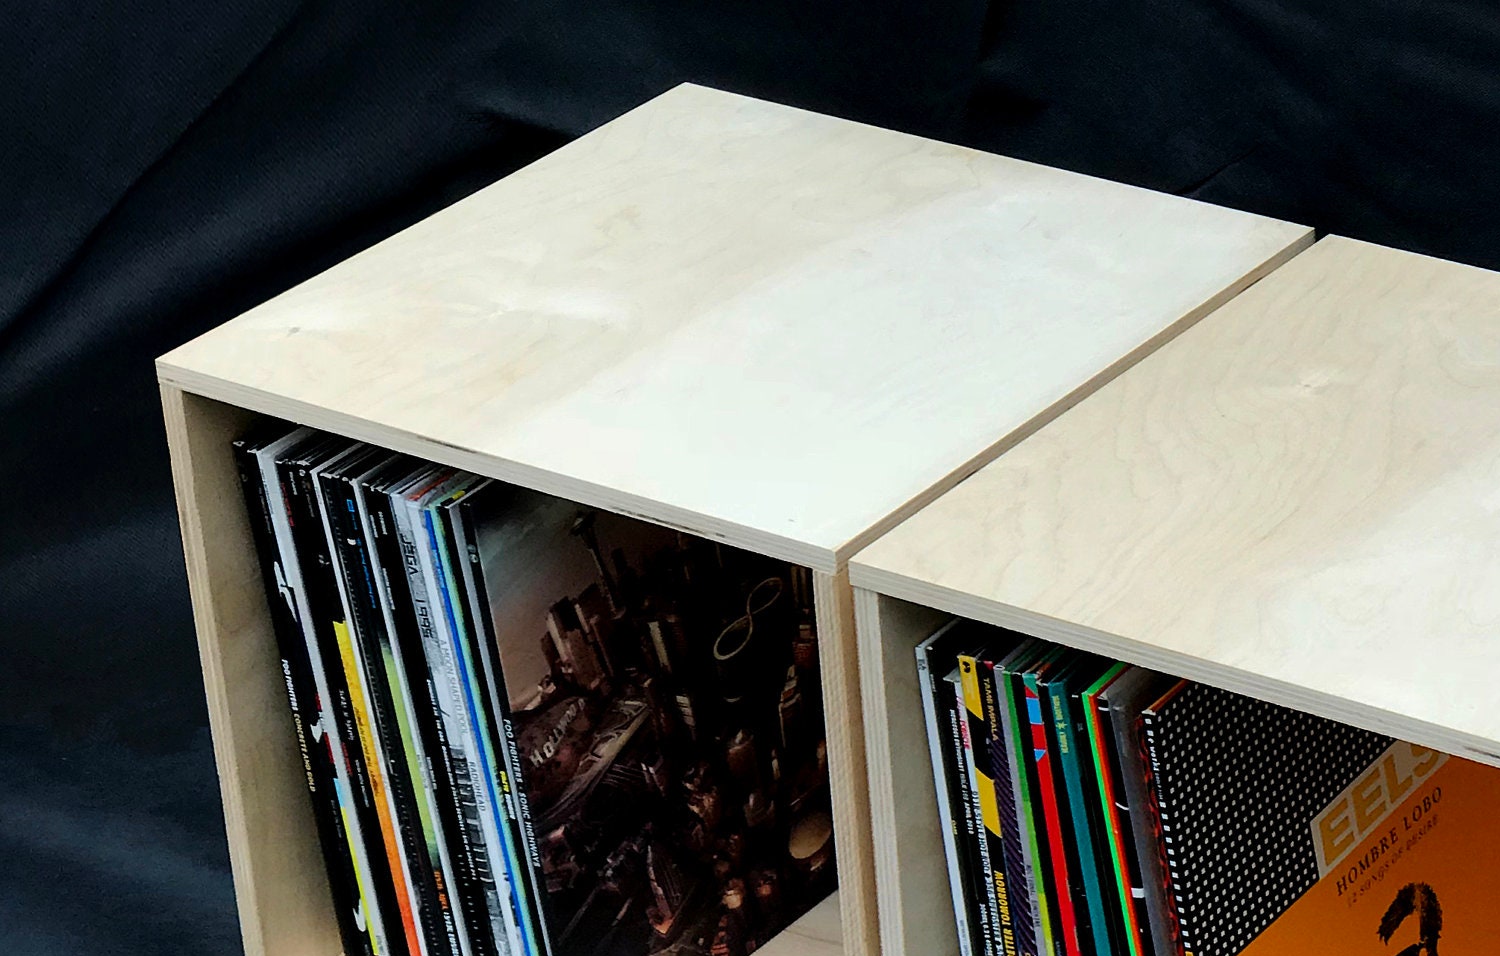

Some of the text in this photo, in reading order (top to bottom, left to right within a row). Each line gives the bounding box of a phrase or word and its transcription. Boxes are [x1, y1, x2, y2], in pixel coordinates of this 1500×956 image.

[415, 599, 435, 638] 1995
[441, 648, 454, 672] MOON
[448, 676, 463, 711] SHAPED
[456, 712, 469, 735] POOL
[983, 677, 1000, 742] TAME IMPALA
[281, 659, 317, 792] FOO FIGHTERS CONCRETE AND GOLD
[503, 719, 515, 738] FOO
[467, 761, 487, 811] RADIOHEAD
[507, 740, 524, 782] FIGHTERS
[517, 792, 531, 819] SONIC
[1319, 744, 1440, 867] EELS
[523, 821, 540, 868] HIGHWAYS
[1336, 787, 1441, 896] HOMBRE LOBO
[993, 870, 1012, 926] TOMORROW
